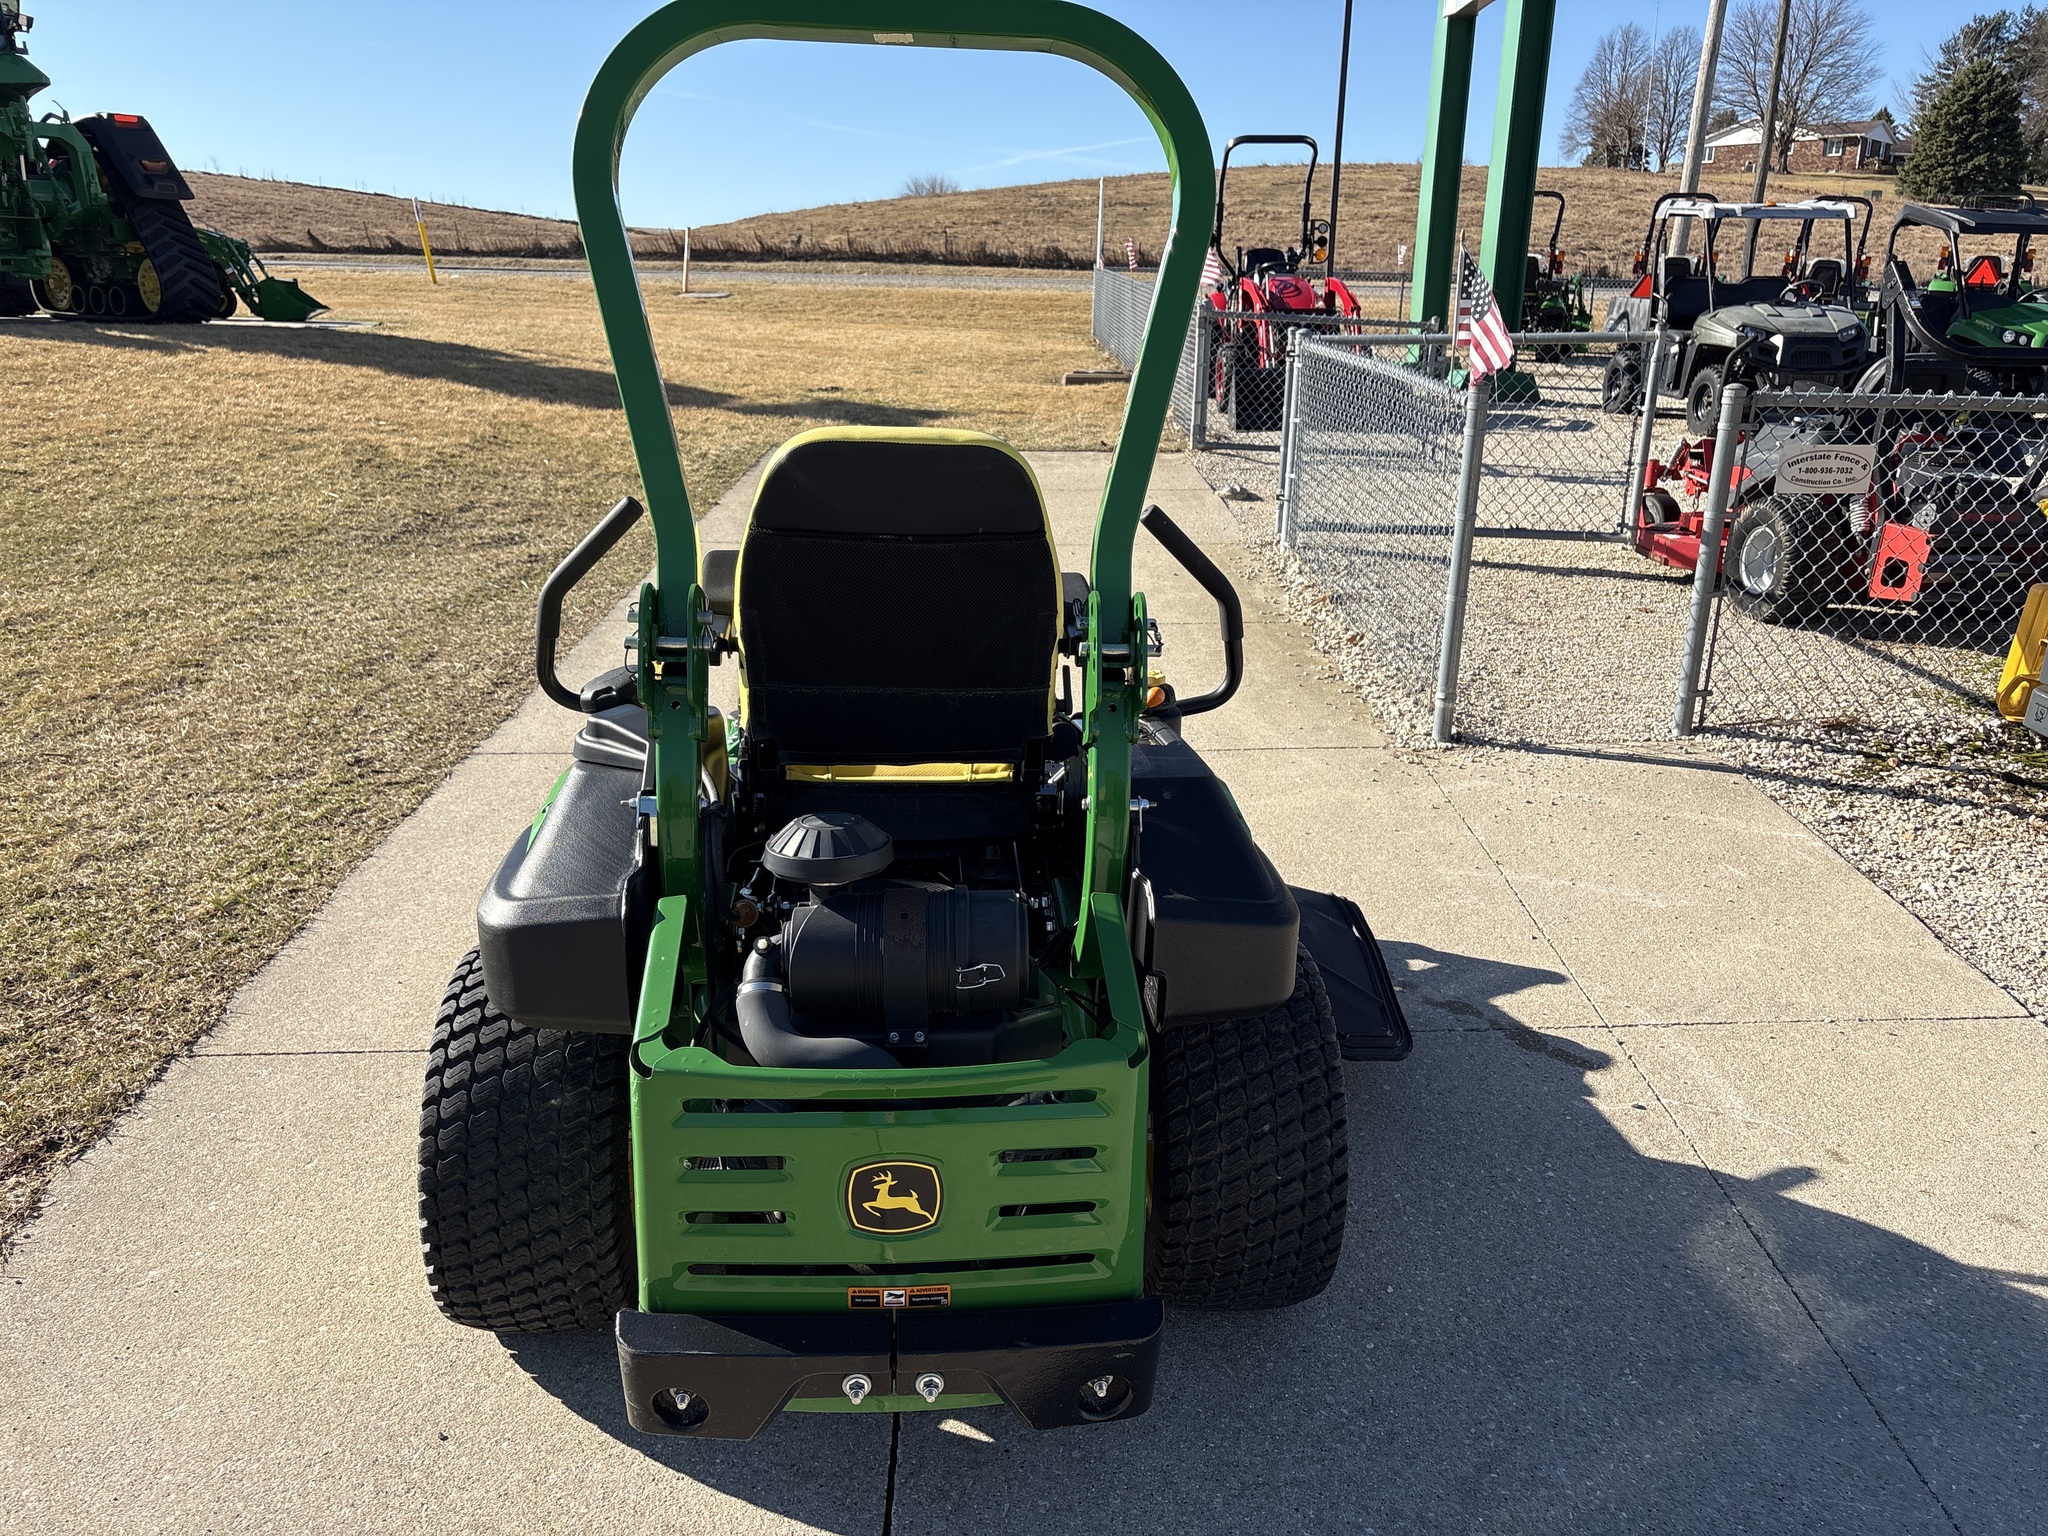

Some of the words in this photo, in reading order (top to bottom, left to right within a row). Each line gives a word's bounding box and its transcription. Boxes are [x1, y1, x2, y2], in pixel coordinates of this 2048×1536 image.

[1787, 453, 1831, 468] Interstate
[1834, 453, 1860, 466] Fence
[1860, 463, 1869, 471] &
[1790, 475, 1831, 485] Construction
